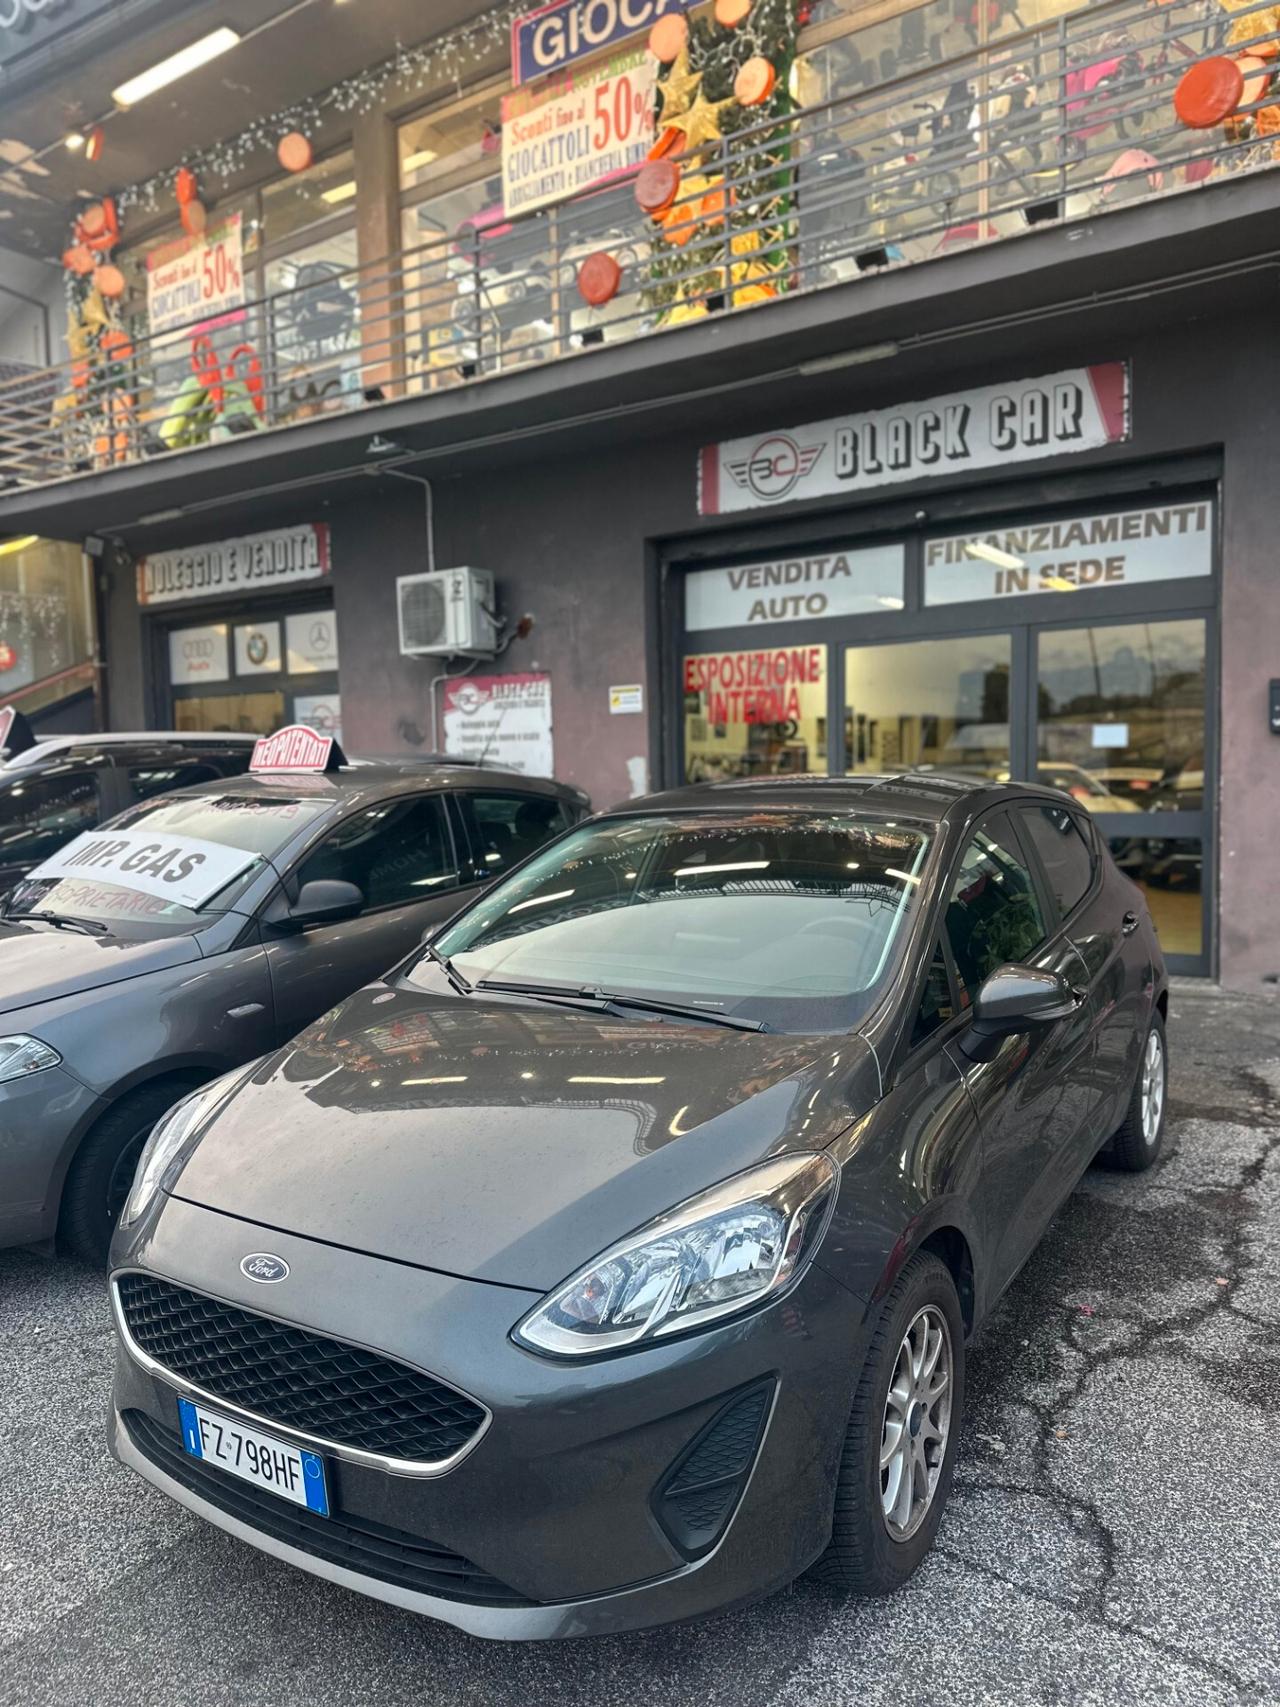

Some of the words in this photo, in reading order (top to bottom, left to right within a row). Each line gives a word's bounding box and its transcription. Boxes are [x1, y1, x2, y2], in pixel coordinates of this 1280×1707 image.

[511, 107, 553, 146] Sconti
[593, 76, 655, 151] 50%
[507, 124, 590, 183] GIOCATTOLI
[203, 243, 241, 299] 50%
[834, 402, 971, 479] BLACK
[988, 382, 1083, 450] CAR
[228, 548, 238, 583] E
[242, 533, 321, 579] VENDITA
[927, 505, 1208, 567] FINANZIAMENTI
[728, 555, 851, 591] VENDITA
[994, 567, 1029, 594] IN
[1039, 555, 1126, 590] SEDE
[747, 592, 828, 622] AUTO
[684, 648, 820, 693] ESPOSIZIONE
[708, 687, 801, 725] INTERNA
[252, 729, 328, 767] NEOPATENTATI
[62, 839, 131, 869] IMP.
[119, 843, 207, 883] GAS
[248, 1256, 279, 1278] Ford
